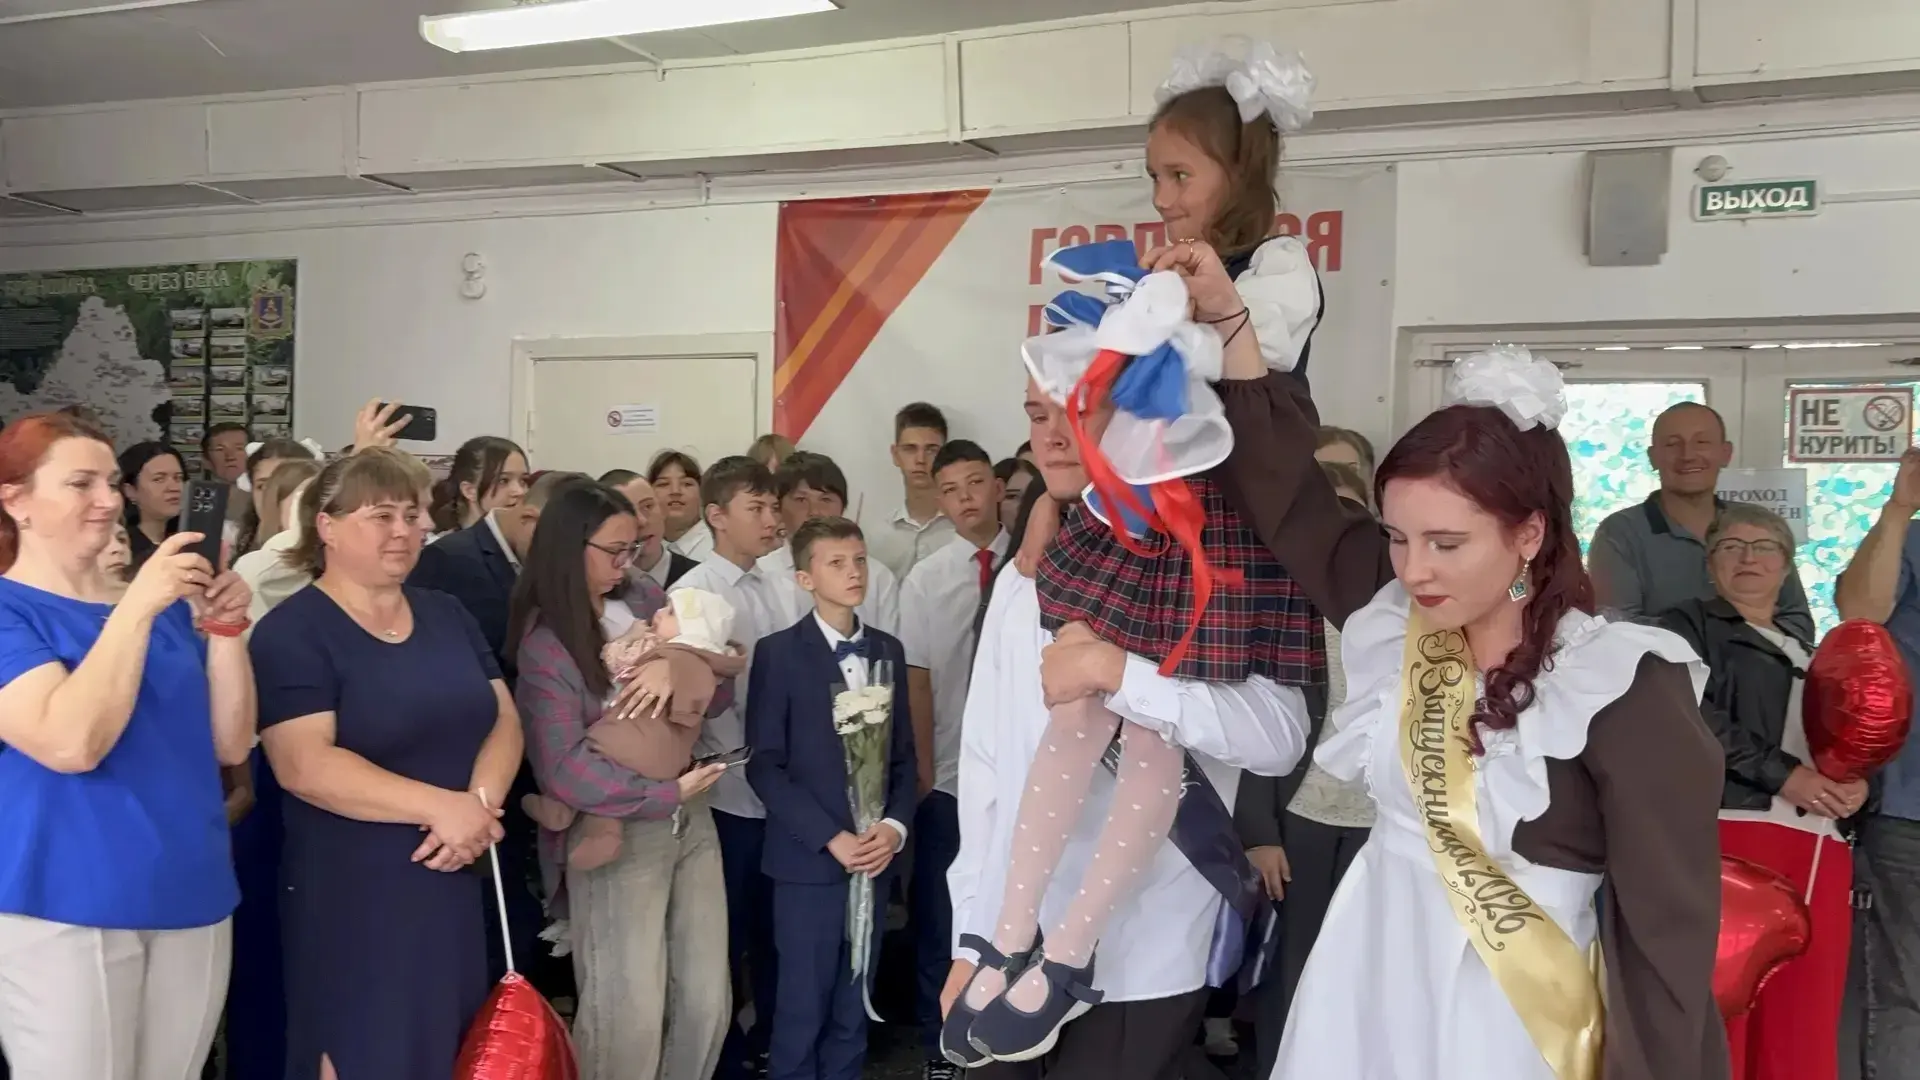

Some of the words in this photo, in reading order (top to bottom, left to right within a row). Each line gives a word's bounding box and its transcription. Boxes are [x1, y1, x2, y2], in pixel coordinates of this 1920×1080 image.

[1706, 186, 1809, 211] ВЫХОД
[127, 273, 180, 292] ЧЕРЕЗ
[183, 269, 230, 289] ВЕКА
[1801, 399, 1840, 426] НЕ
[1800, 435, 1896, 454] КУРИТЬ!
[1717, 488, 1788, 502] ПРОХОД
[1457, 865, 1545, 934] 2026
